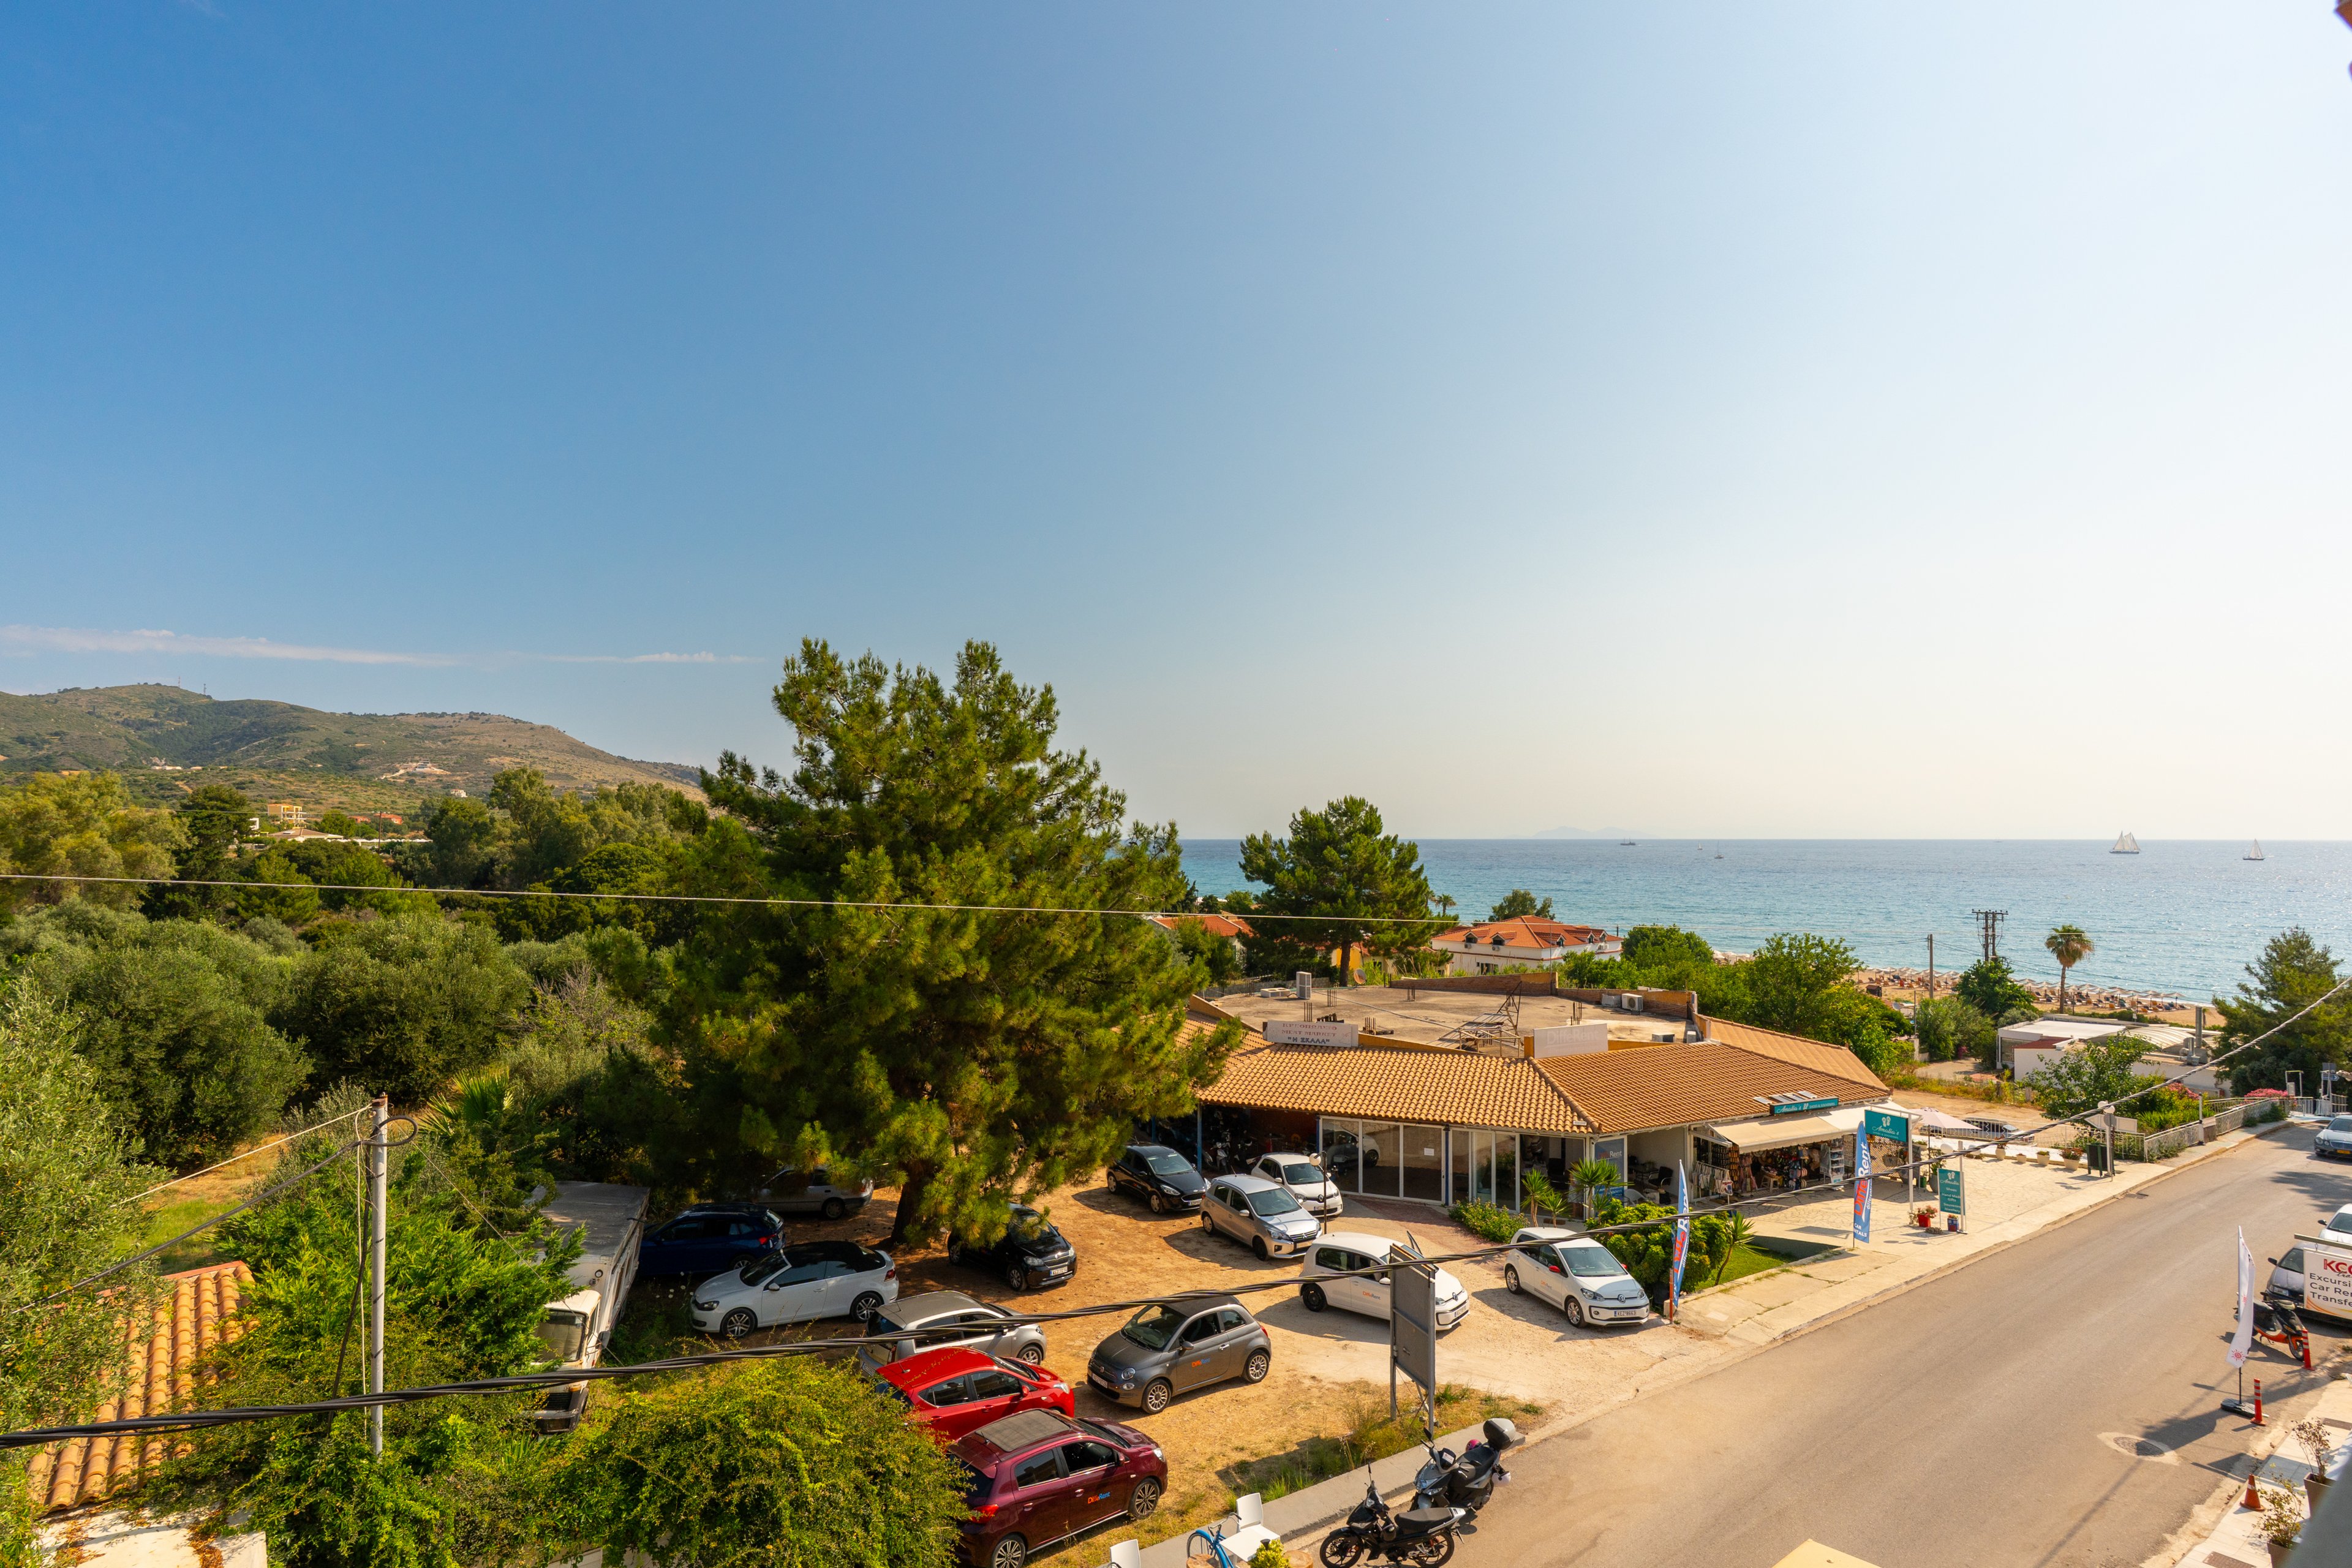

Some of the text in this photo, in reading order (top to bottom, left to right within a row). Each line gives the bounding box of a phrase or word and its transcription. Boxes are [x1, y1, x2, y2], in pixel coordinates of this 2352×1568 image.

[1872, 1125, 1899, 1136] Amalia's
[2310, 1273, 2352, 1287] Excursi
[2310, 1282, 2330, 1292] Car
